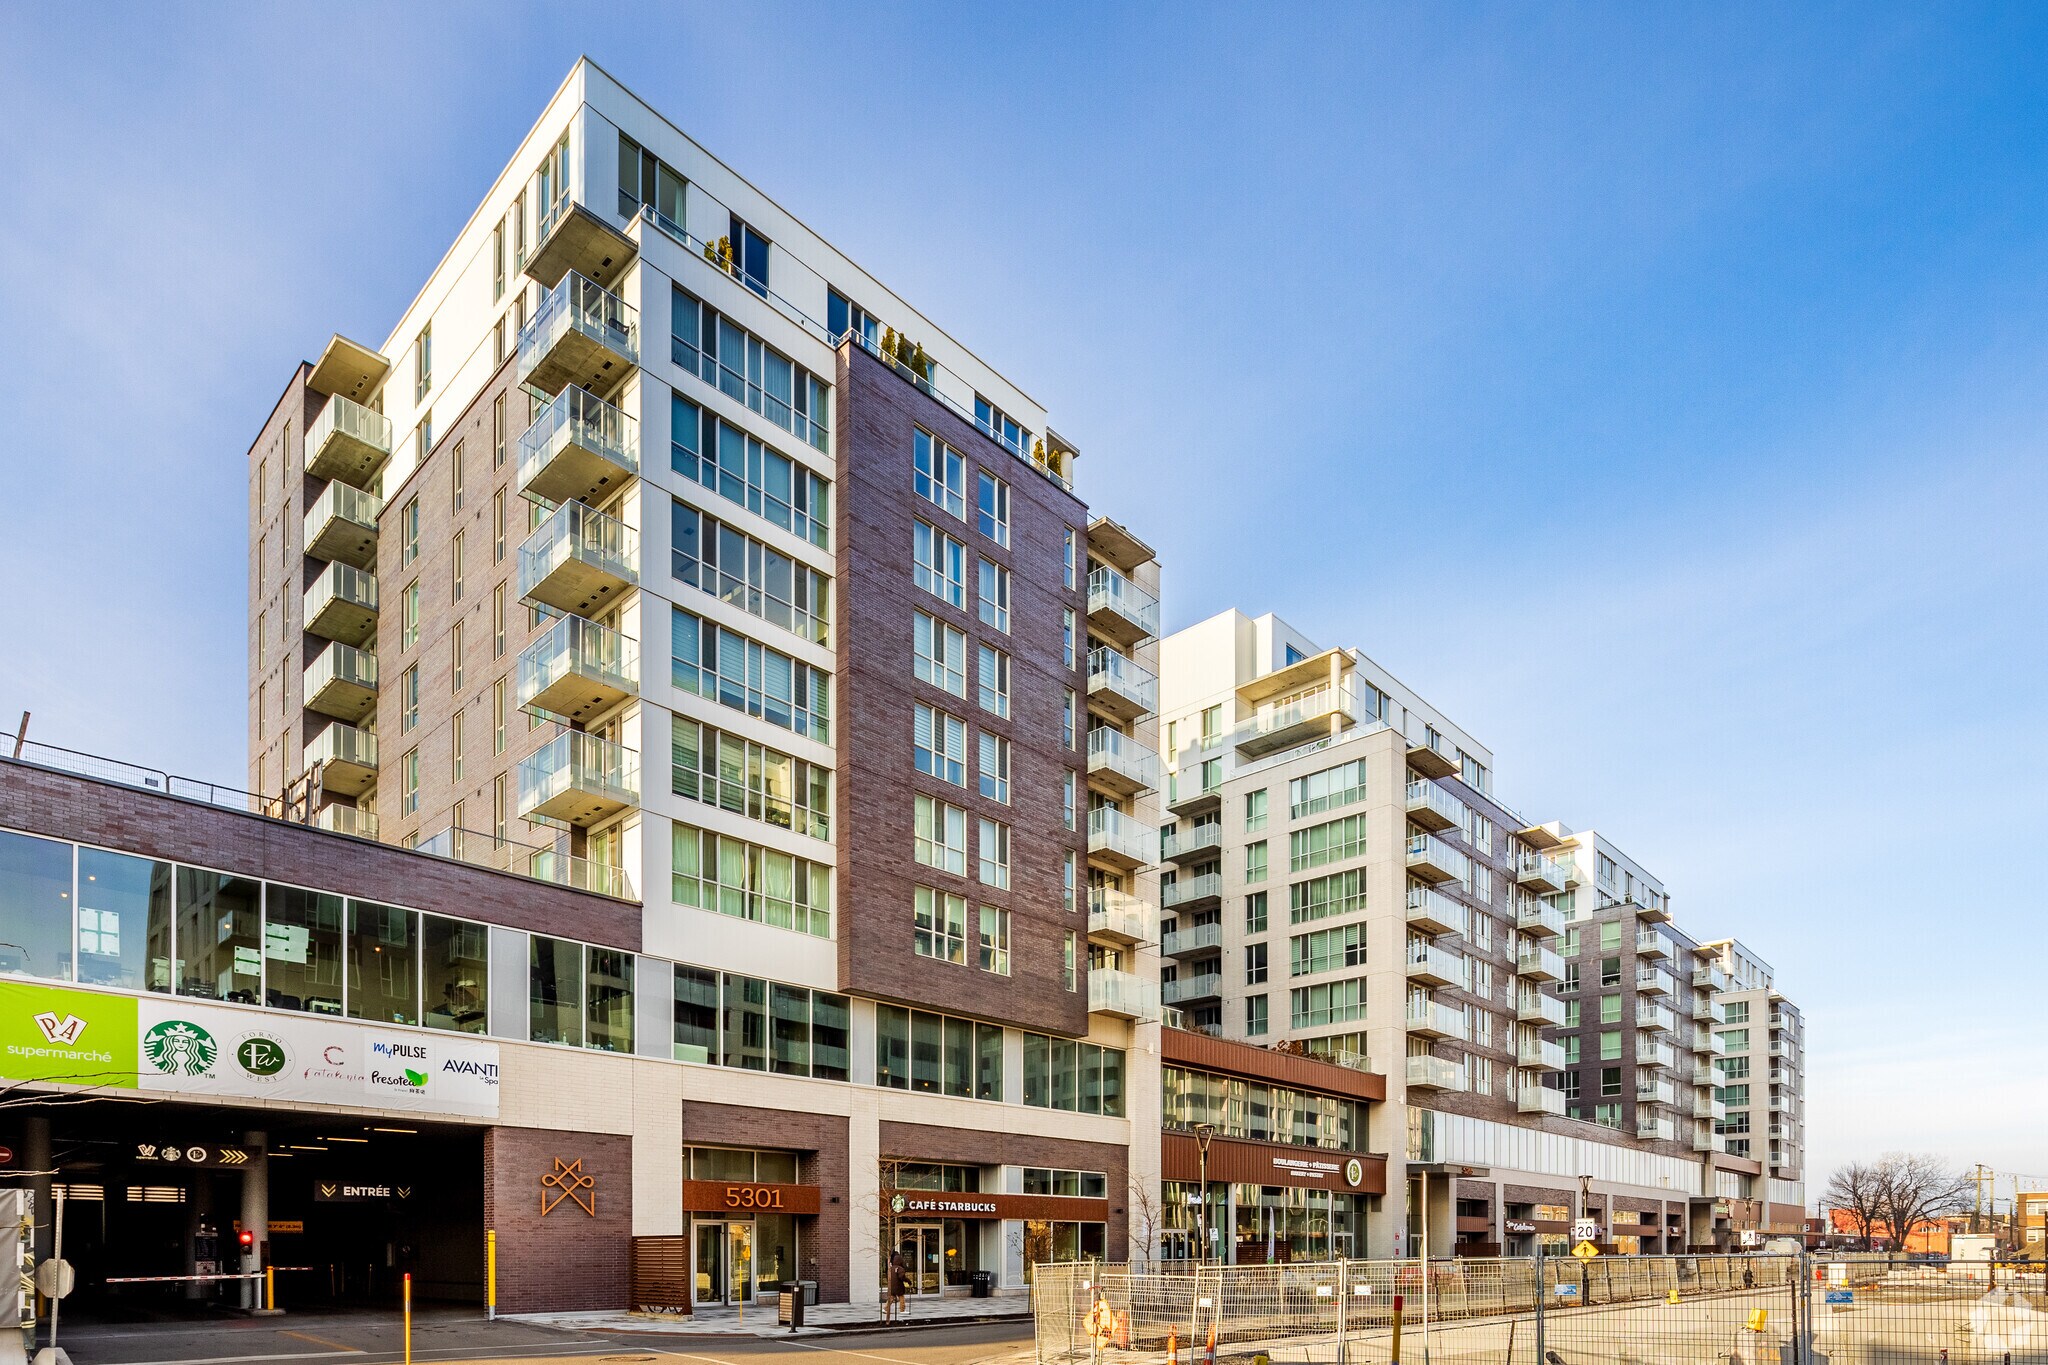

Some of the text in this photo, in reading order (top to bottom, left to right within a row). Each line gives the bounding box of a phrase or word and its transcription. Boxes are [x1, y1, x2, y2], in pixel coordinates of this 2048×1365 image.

[39, 1017, 78, 1041] PA
[241, 1031, 283, 1045] FORNO
[7, 1045, 112, 1063] supermarché
[443, 1059, 498, 1078] AVANTI
[246, 1073, 278, 1082] WEST
[371, 1070, 417, 1087] Presotea
[485, 1077, 498, 1086] Spa
[343, 1185, 390, 1197] ENTRÉE
[725, 1187, 784, 1208] 5301
[909, 1198, 996, 1213] CAFÉ STARBUCKS
[1577, 1226, 1593, 1238] 20
